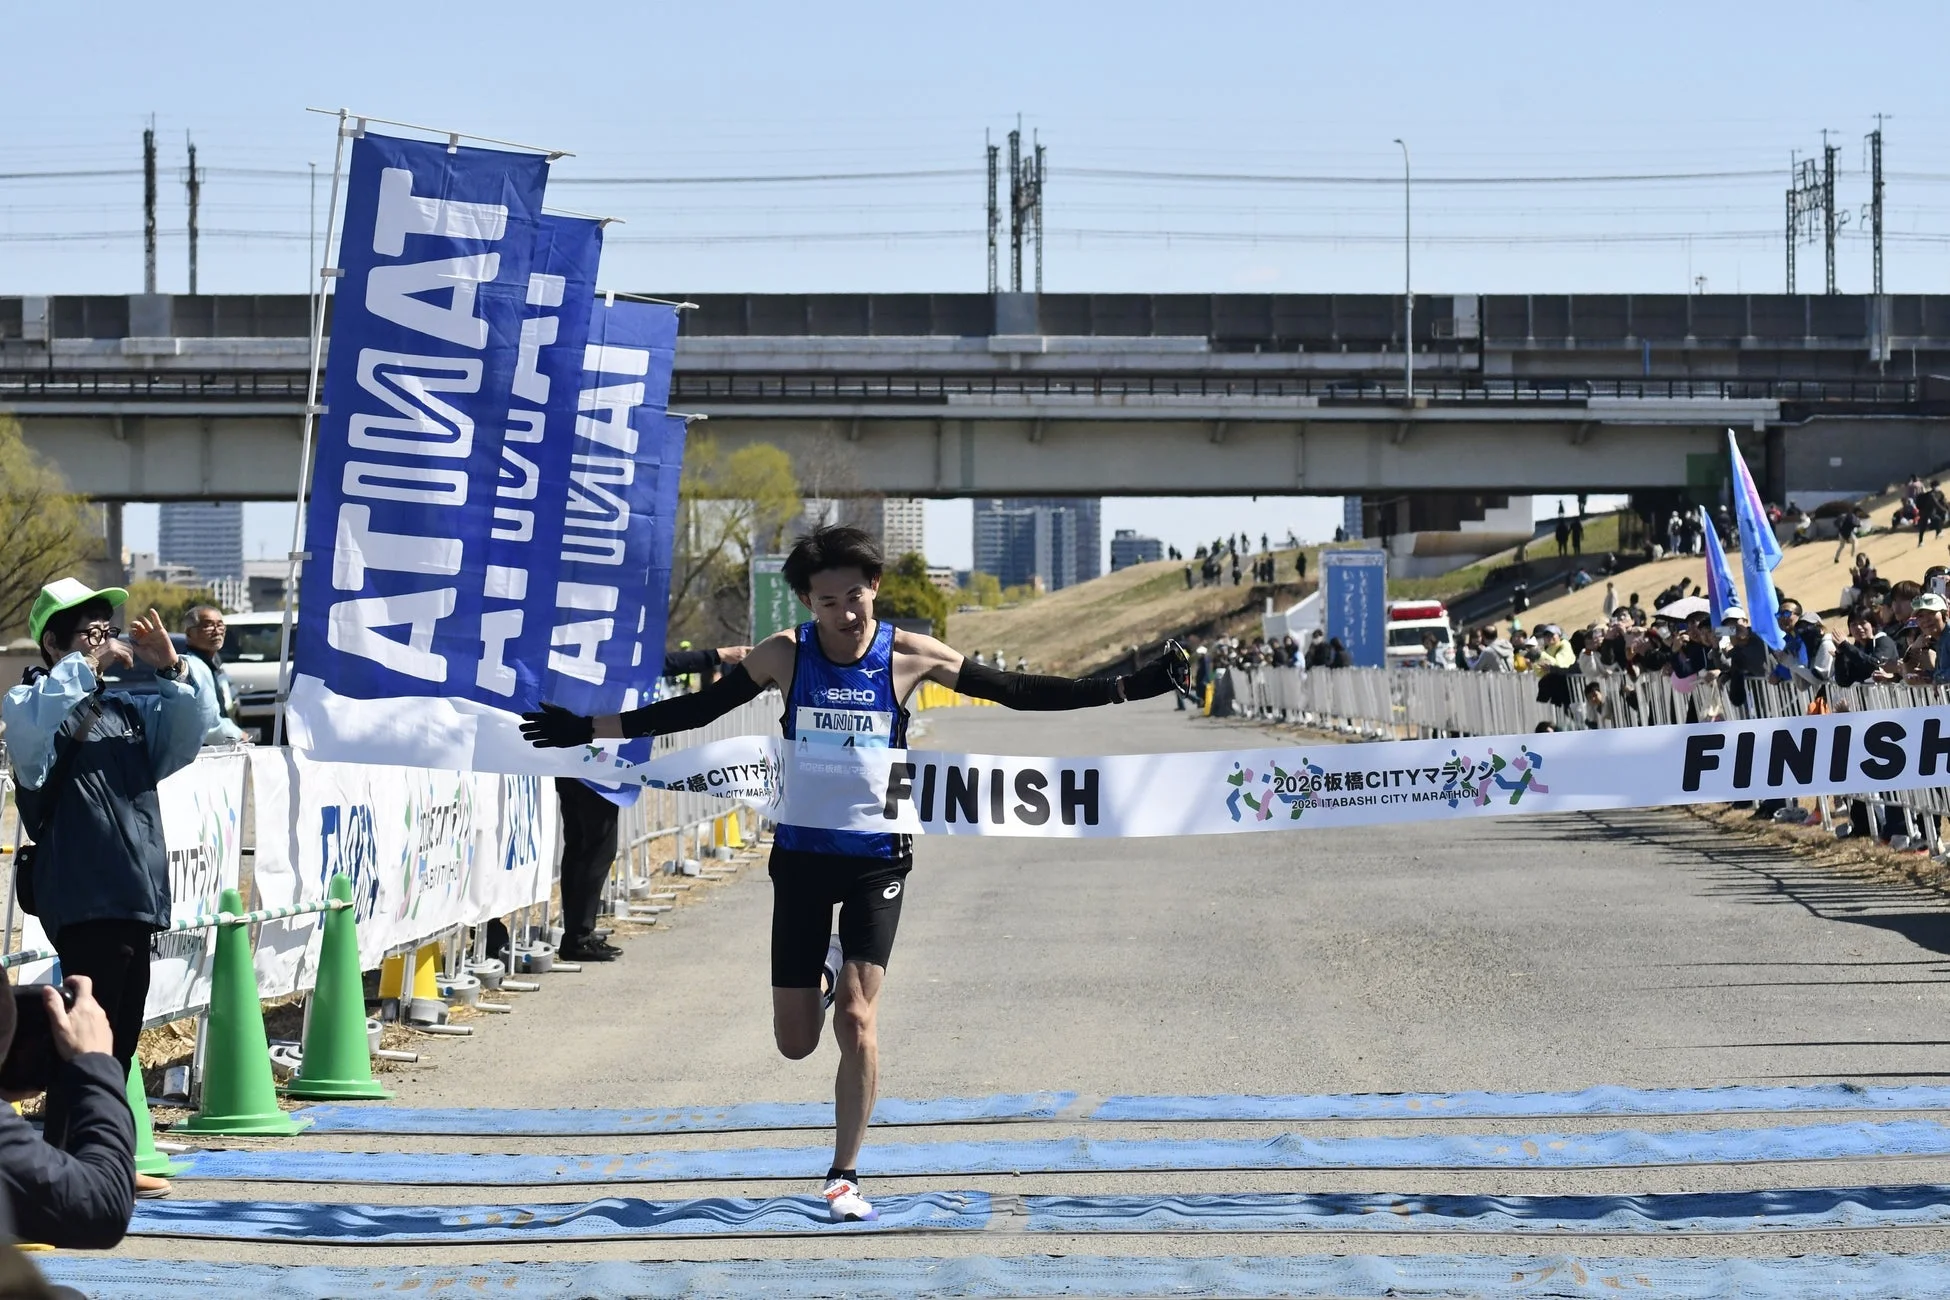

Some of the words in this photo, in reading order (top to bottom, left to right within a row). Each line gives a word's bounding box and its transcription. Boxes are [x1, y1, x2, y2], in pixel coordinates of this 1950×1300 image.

[827, 687, 876, 703] sato
[813, 712, 874, 732] TANITA
[1273, 764, 1495, 793] 2026板橋CITYマラソン
[883, 763, 1099, 826] FINISH
[1292, 799, 1318, 809] 2026
[1321, 794, 1377, 808] ITABASHI
[1381, 793, 1408, 804] CITY
[1412, 788, 1479, 802] MARATHON
